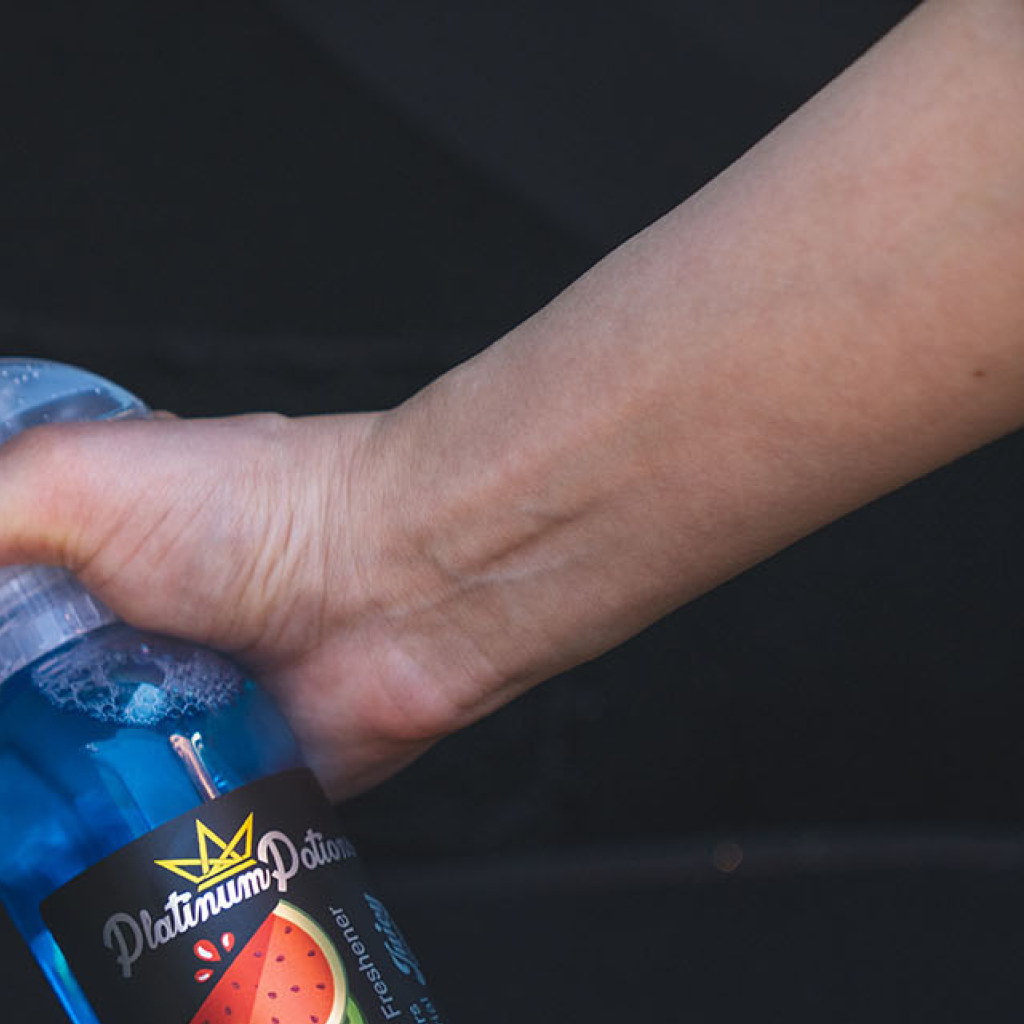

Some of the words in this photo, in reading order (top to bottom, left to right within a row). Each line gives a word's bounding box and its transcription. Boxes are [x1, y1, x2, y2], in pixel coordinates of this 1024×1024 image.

[103, 867, 271, 978] Platinum
[257, 829, 357, 892] Potion
[329, 907, 402, 1019] Freshener
